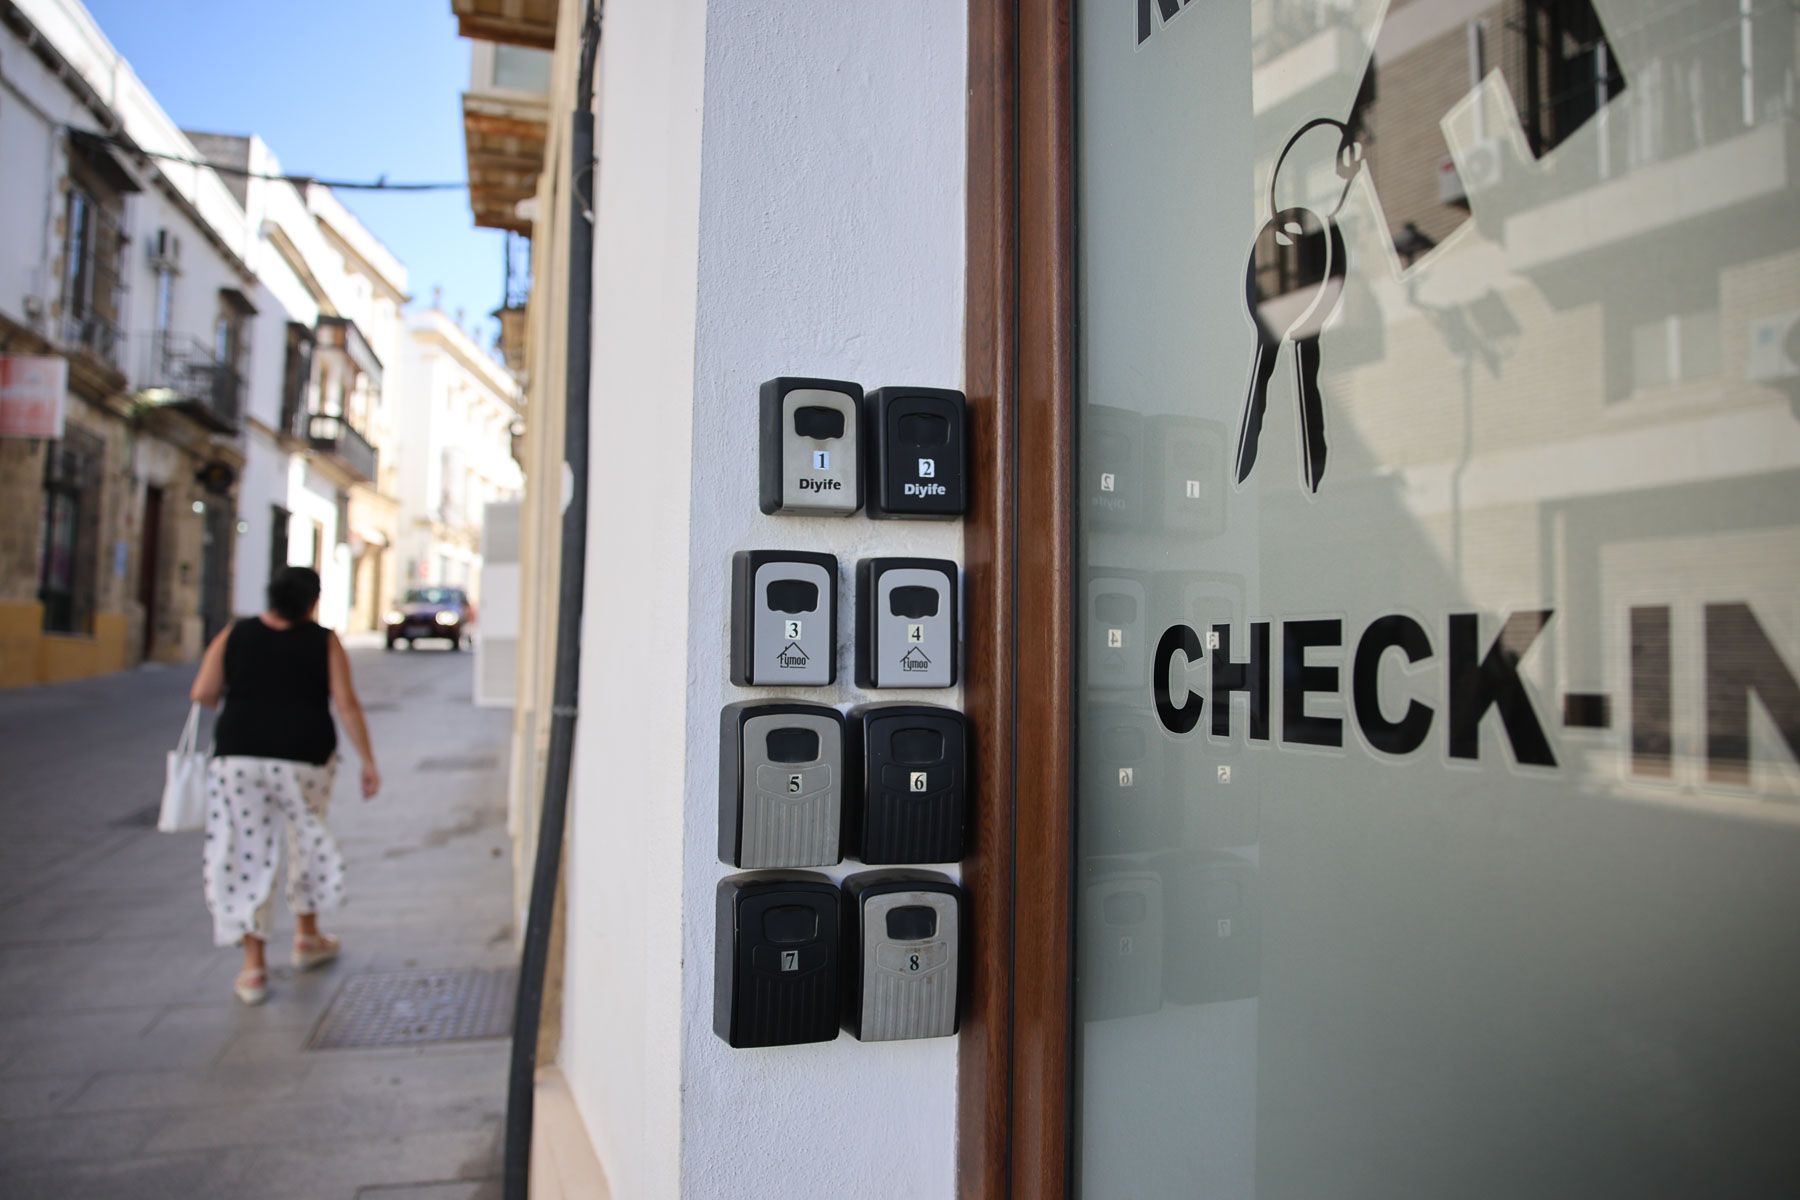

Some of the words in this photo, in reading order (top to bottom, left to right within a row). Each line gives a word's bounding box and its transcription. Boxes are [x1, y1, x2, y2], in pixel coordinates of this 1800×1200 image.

[818, 452, 826, 469] 1
[922, 460, 932, 476] 2
[799, 478, 842, 493] Diyife
[904, 483, 946, 498] Diyife
[788, 622, 799, 639] 3
[911, 626, 921, 641] 4
[1153, 601, 1800, 784] CHECK-IN
[789, 775, 800, 792] 5
[914, 775, 924, 791] 6
[785, 952, 796, 969] 7
[909, 954, 920, 971] 8
